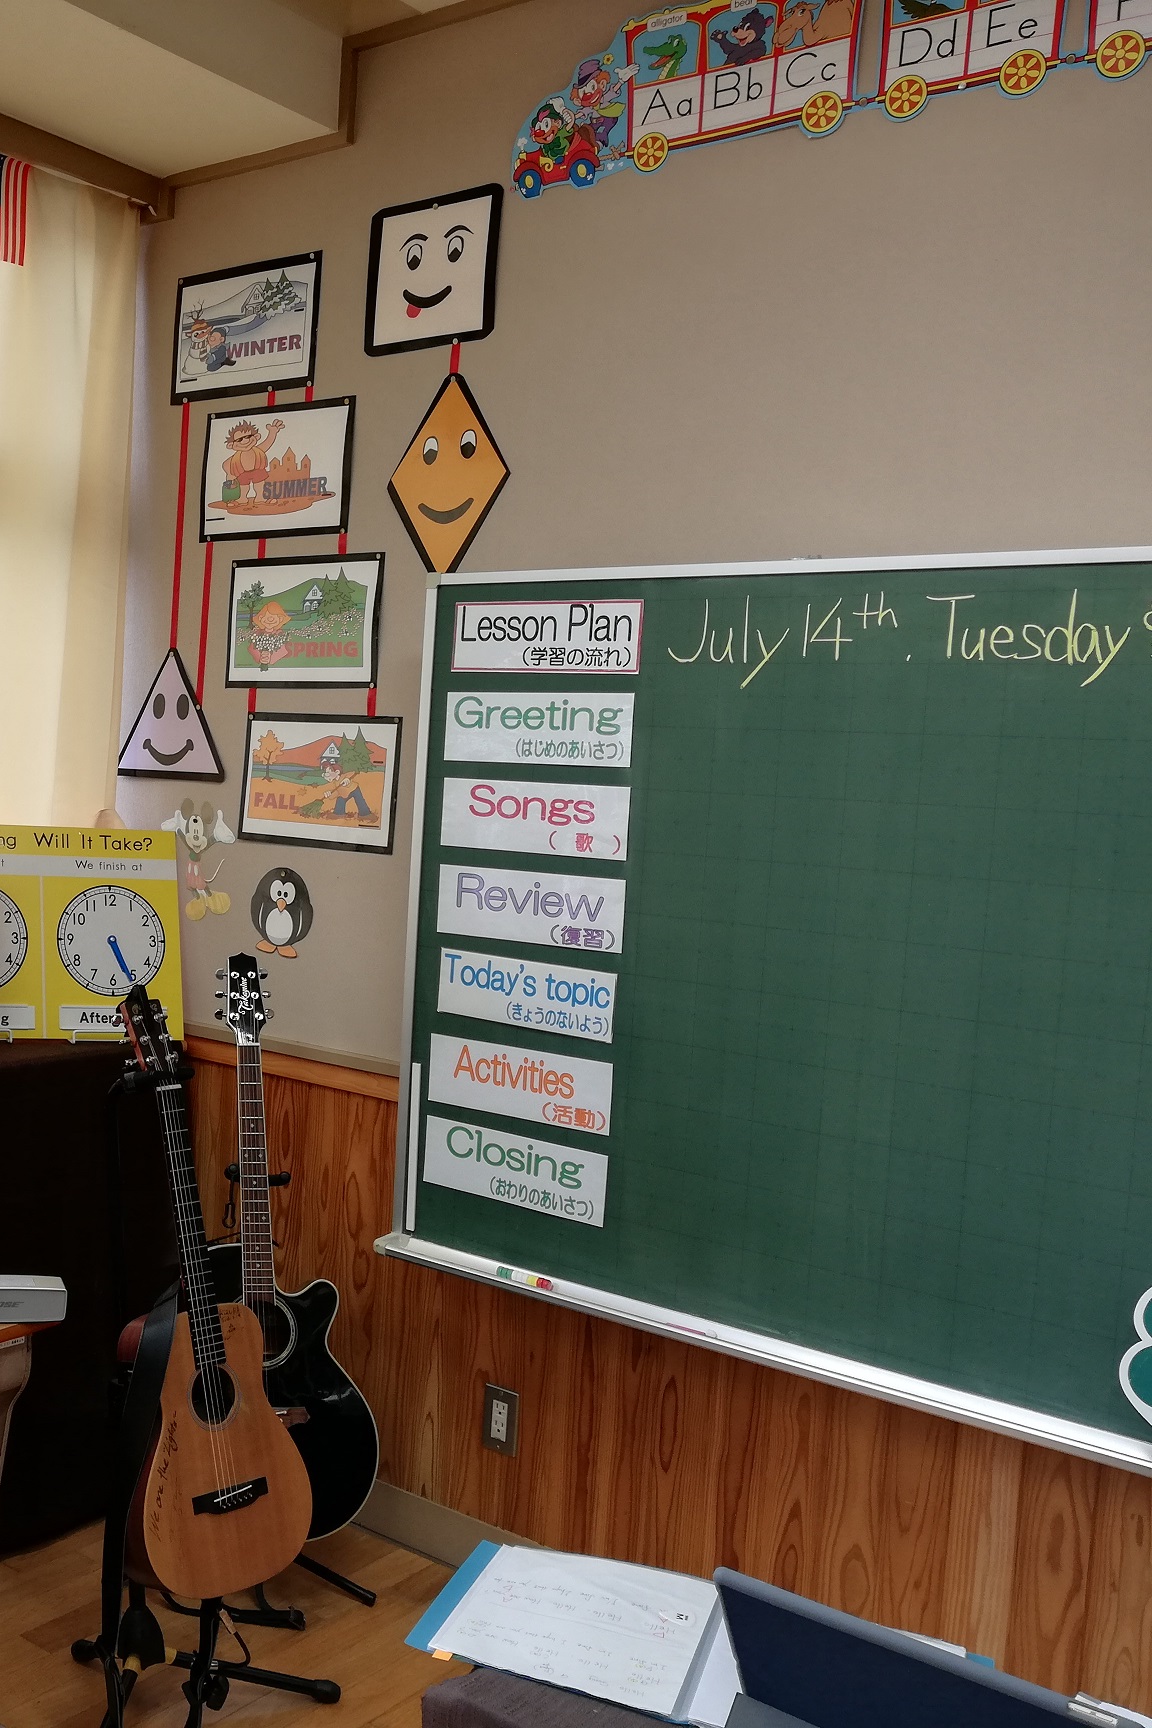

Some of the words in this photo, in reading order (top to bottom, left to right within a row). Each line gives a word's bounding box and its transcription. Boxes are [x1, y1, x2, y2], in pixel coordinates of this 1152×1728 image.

[650, 13, 685, 28] alligator
[225, 333, 302, 359] WINTER
[262, 476, 328, 500] SUMMER
[460, 604, 557, 642] Lesson
[567, 603, 632, 642] Plan
[667, 594, 789, 690] July
[926, 588, 1131, 688] Tuesday
[284, 640, 359, 659] SPRING
[453, 695, 624, 736] Greeting
[253, 791, 299, 812] FALL
[468, 784, 596, 827] Songs
[33, 832, 69, 849] Will
[81, 834, 93, 850] It
[99, 834, 153, 852] Take?
[75, 859, 93, 870] We
[99, 861, 126, 871] finish
[131, 863, 143, 871] at
[104, 894, 117, 907] 12
[456, 872, 605, 922] Review
[4, 911, 12, 923] 2
[72, 912, 86, 926] 10
[141, 914, 150, 927] 2
[11, 932, 19, 944] 3
[66, 933, 74, 945] 9
[148, 935, 157, 948] 3
[5, 953, 13, 965] 4
[73, 954, 81, 967] 8
[143, 956, 151, 968] 4
[90, 968, 98, 981] 7
[109, 973, 117, 986] 6
[444, 953, 537, 997] Today's
[545, 973, 611, 1010] topic
[80, 1011, 119, 1024] After
[453, 1044, 575, 1100] Activities
[446, 1125, 585, 1190] Closing
